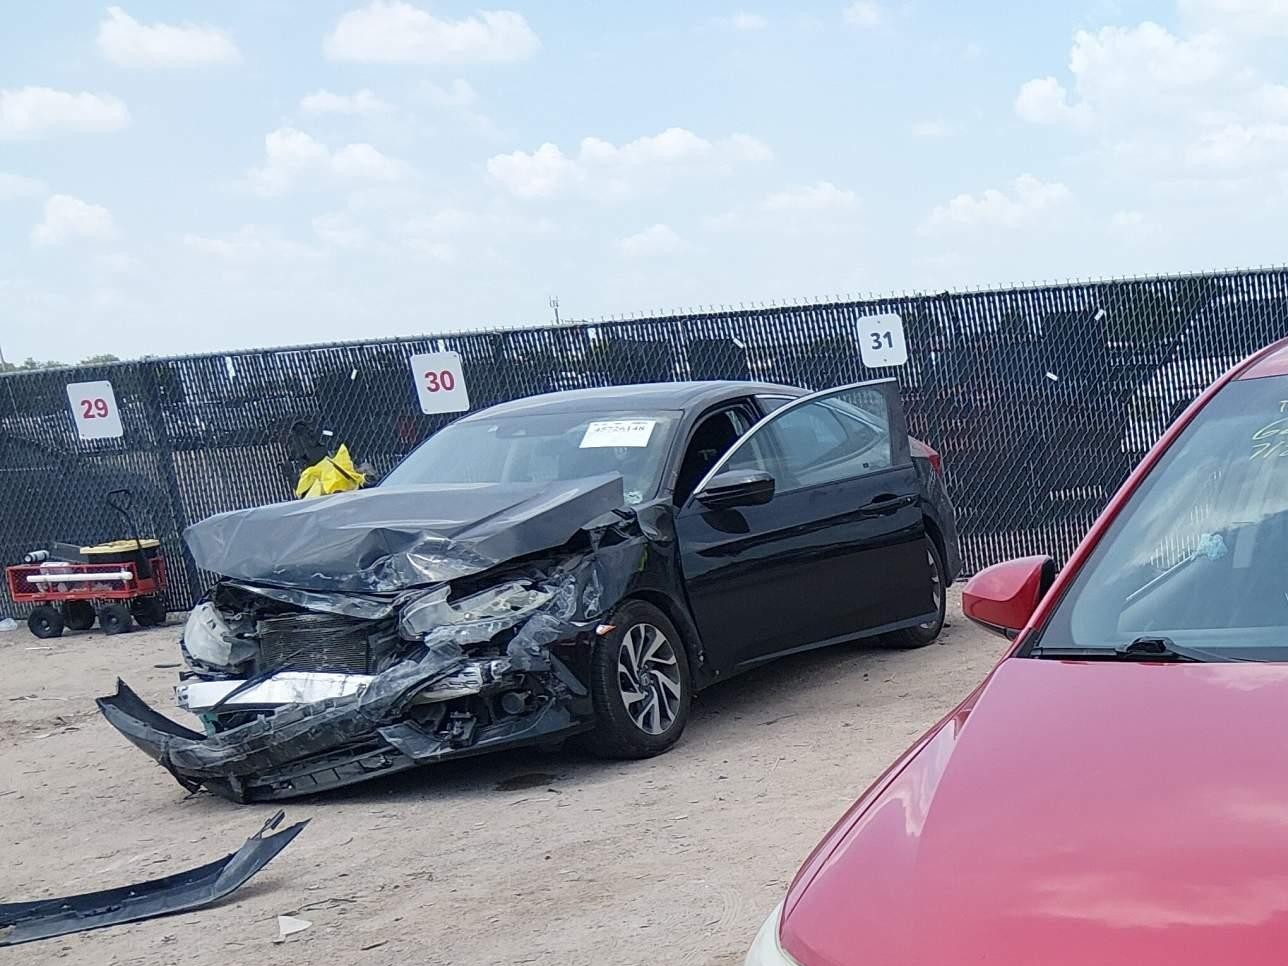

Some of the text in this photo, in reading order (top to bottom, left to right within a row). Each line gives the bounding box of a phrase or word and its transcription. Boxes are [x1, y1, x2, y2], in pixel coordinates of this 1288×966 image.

[870, 330, 894, 351] 31
[424, 369, 456, 393] 30
[79, 398, 110, 420] 29
